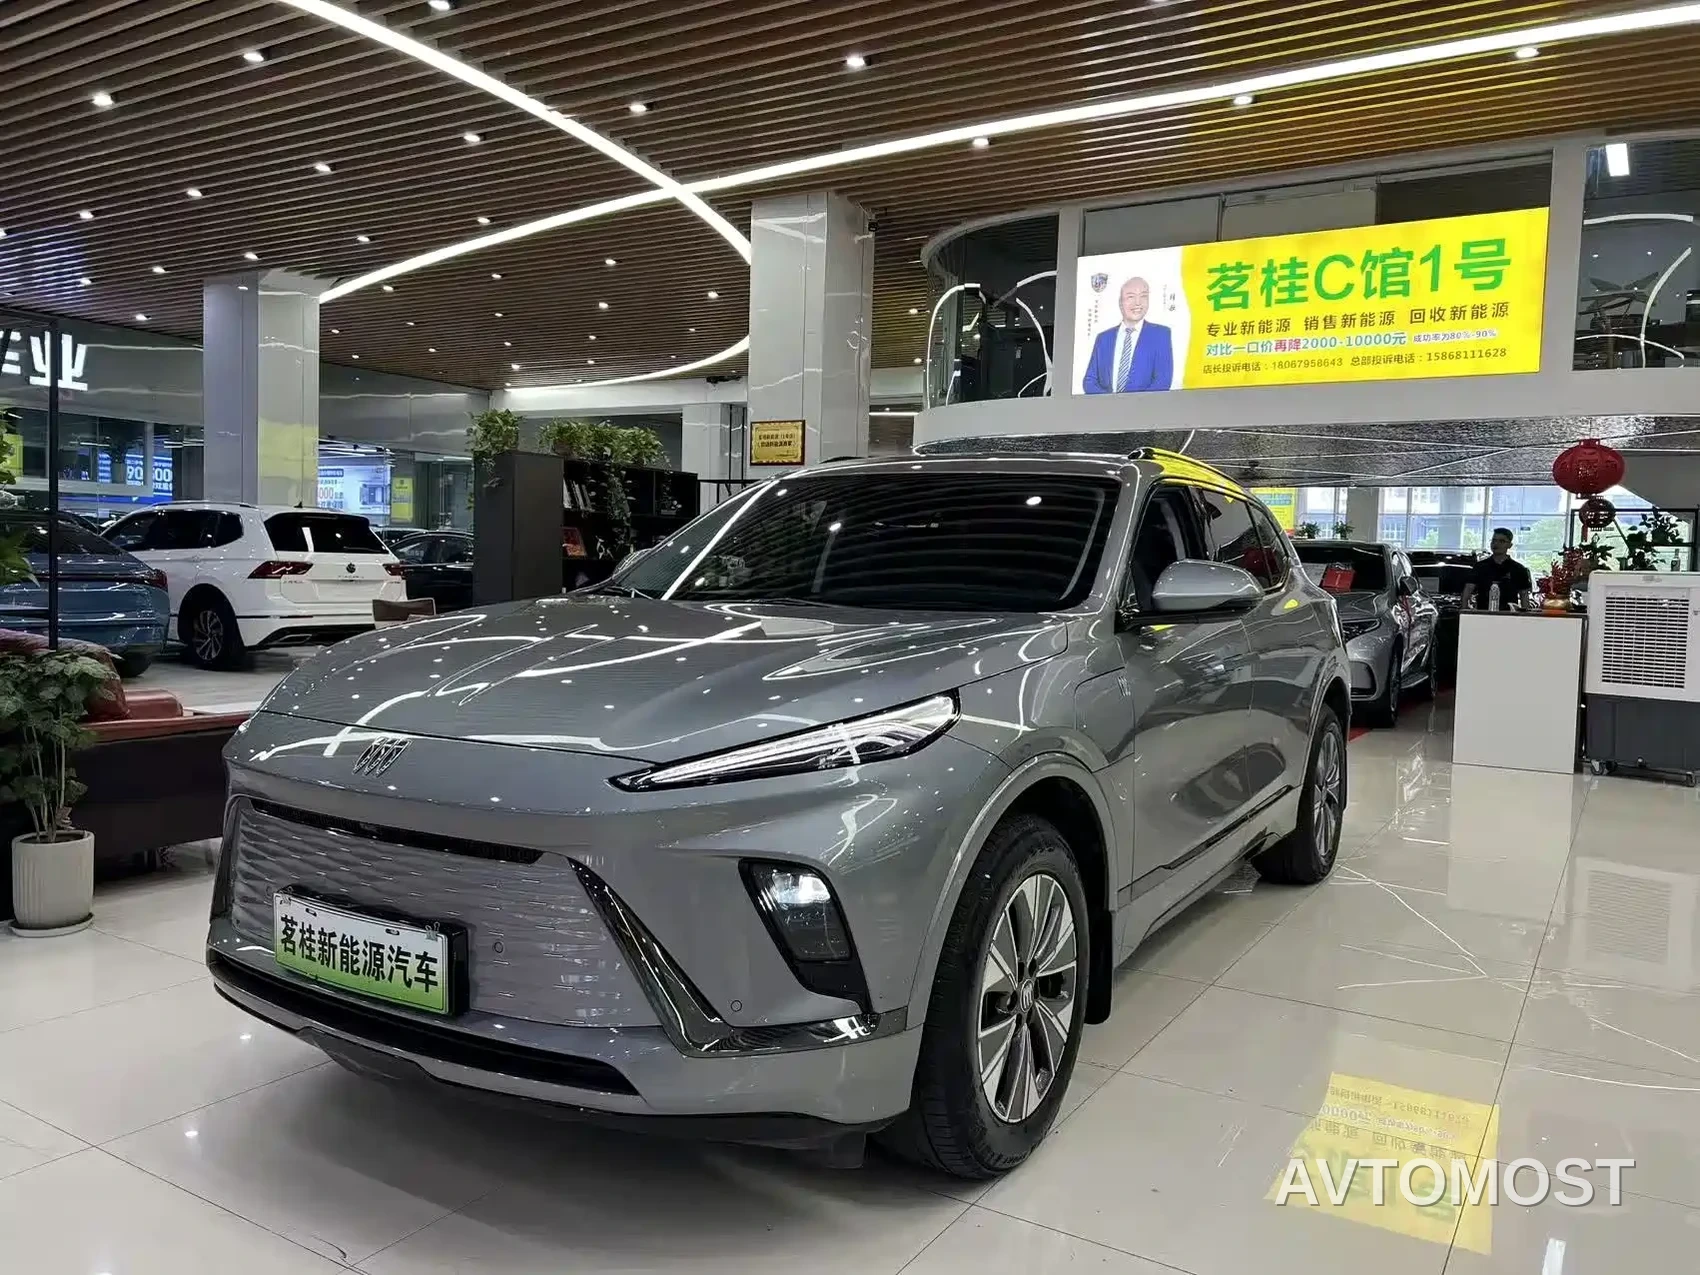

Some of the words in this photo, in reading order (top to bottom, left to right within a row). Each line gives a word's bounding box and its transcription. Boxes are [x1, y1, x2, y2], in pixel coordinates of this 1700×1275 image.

[1206, 238, 1512, 312] 茗桂C馆1号
[1206, 318, 1292, 338] 专业新能源
[1303, 310, 1396, 332] 销售新能源
[1409, 301, 1510, 325] 回收新能源
[1206, 332, 1407, 357] 对比一口价再降2000-10000元
[280, 914, 439, 993] 茗桂新能源汽车
